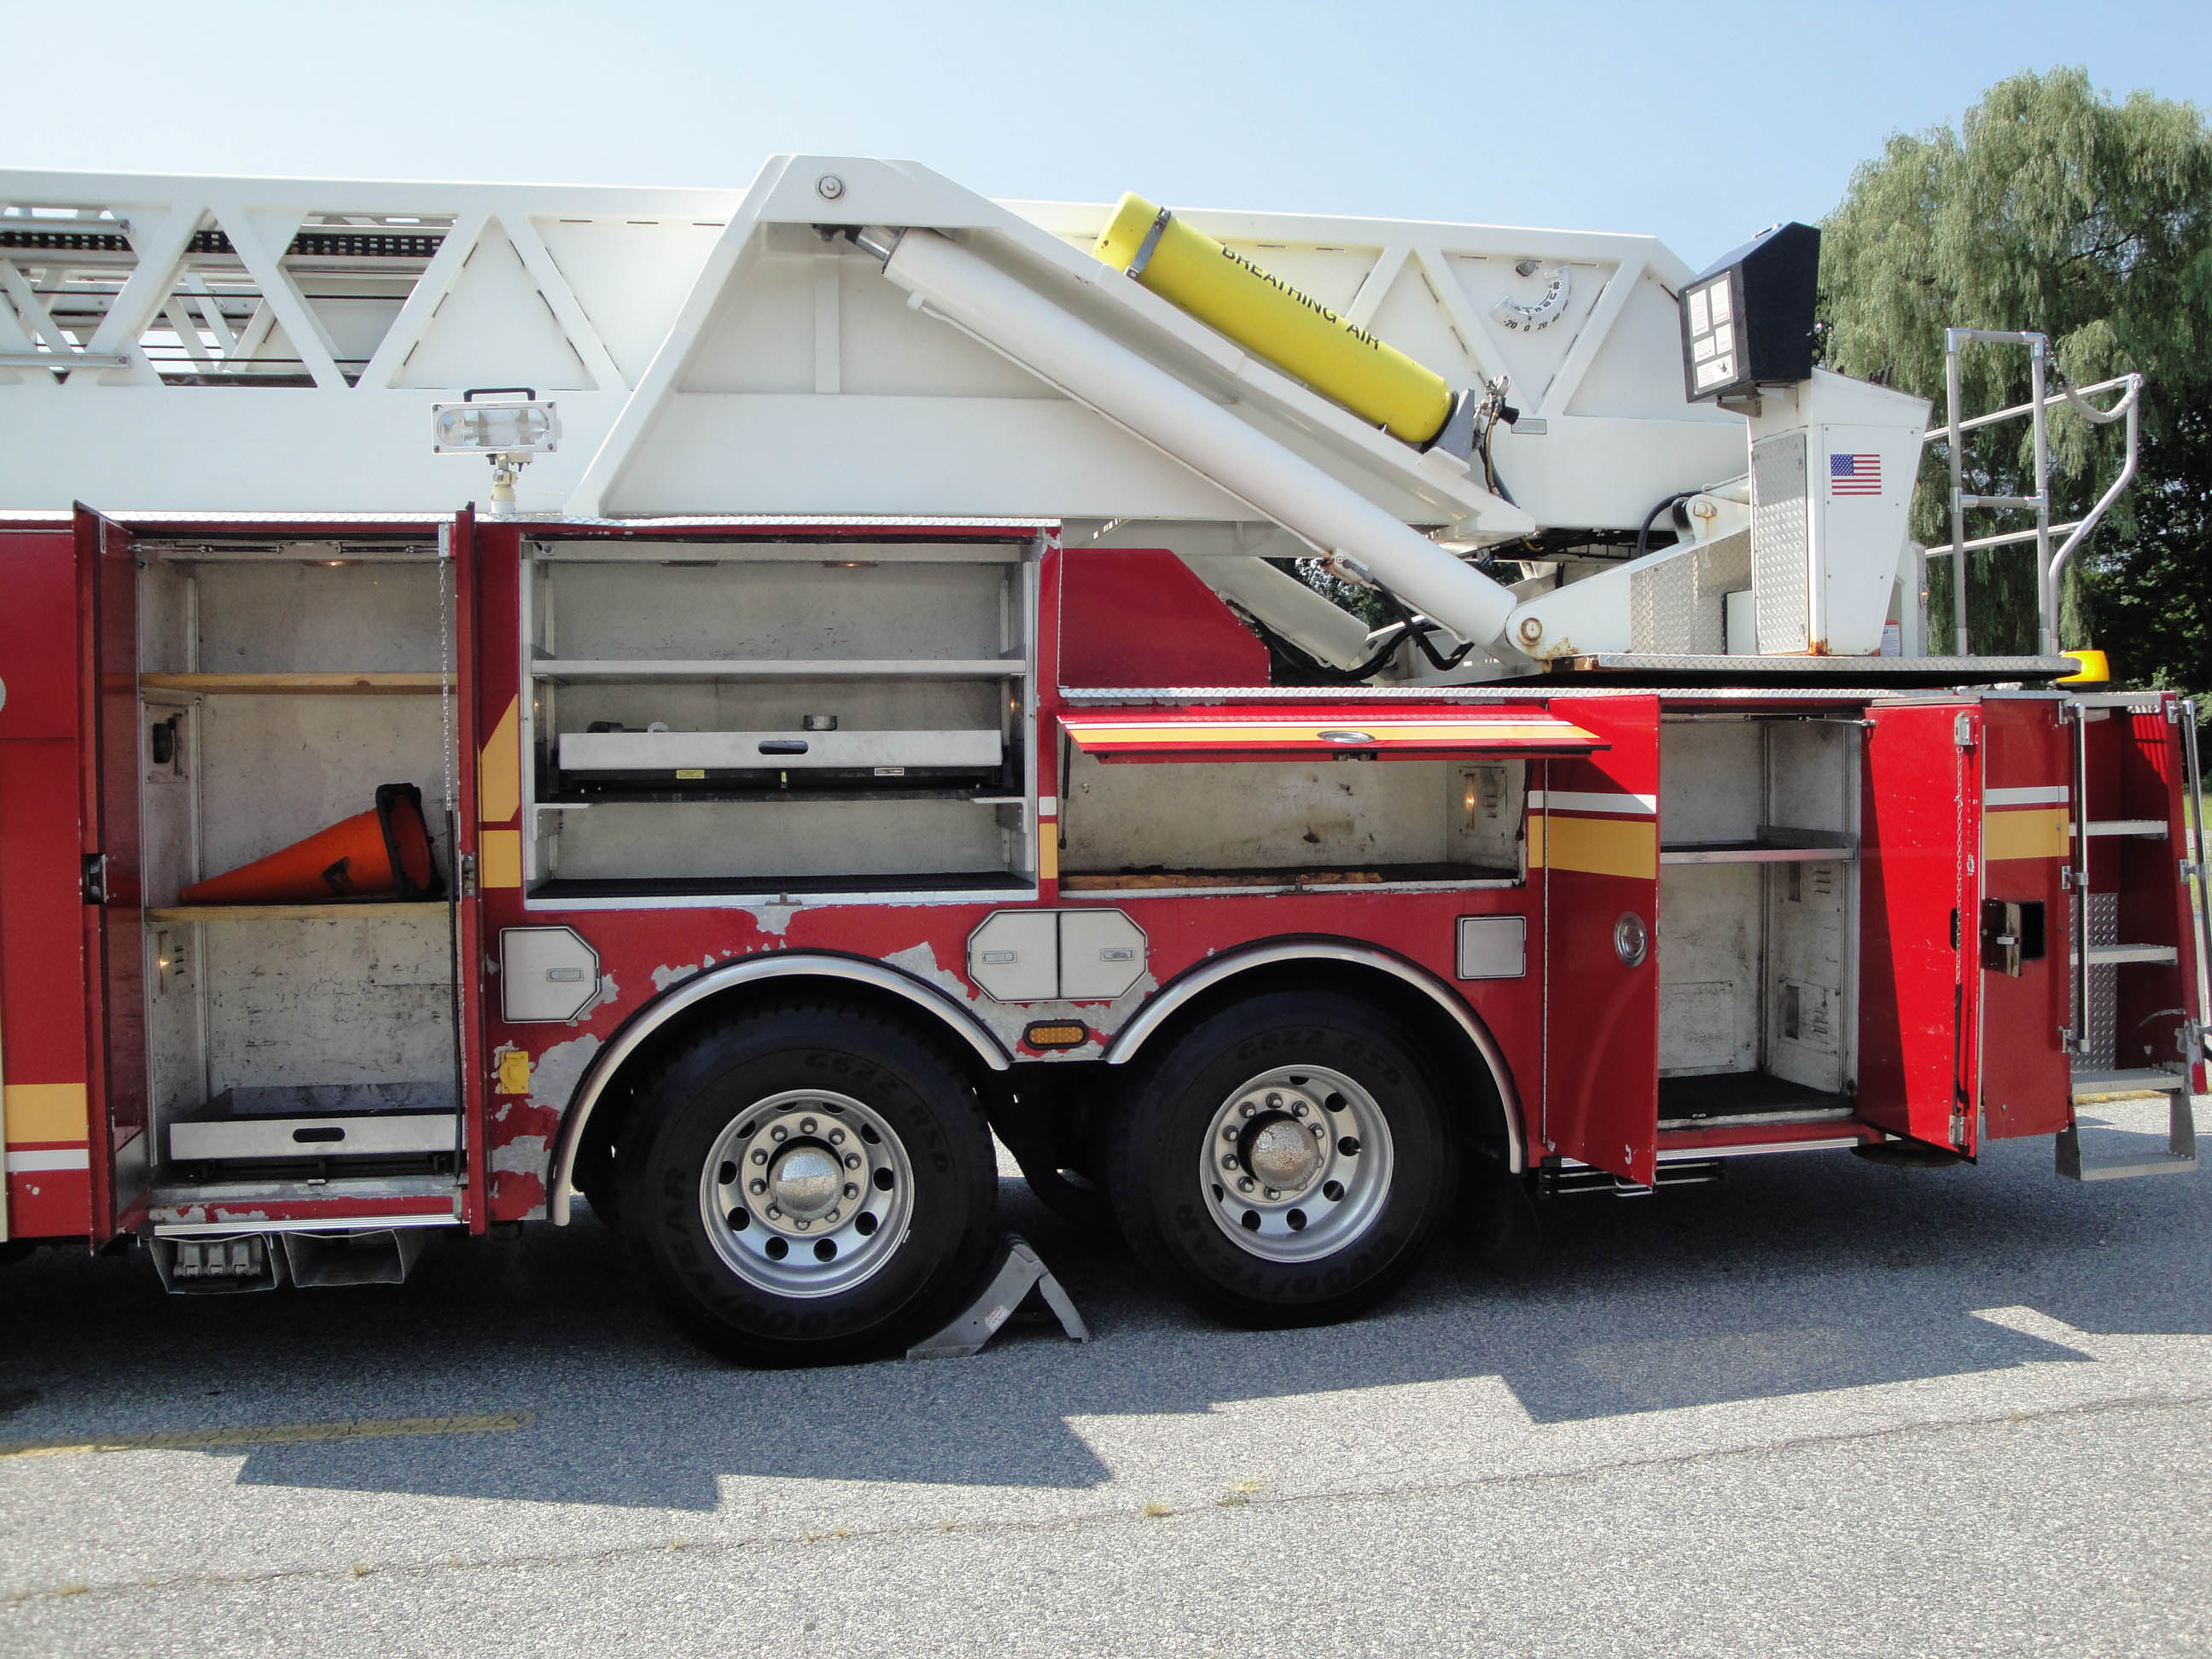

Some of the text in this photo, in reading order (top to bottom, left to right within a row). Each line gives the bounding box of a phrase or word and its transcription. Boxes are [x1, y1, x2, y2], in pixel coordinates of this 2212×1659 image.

[1221, 246, 1379, 351] BREATHING AIR
[1237, 1029, 1324, 1061] G622
[805, 1052, 899, 1097] G622
